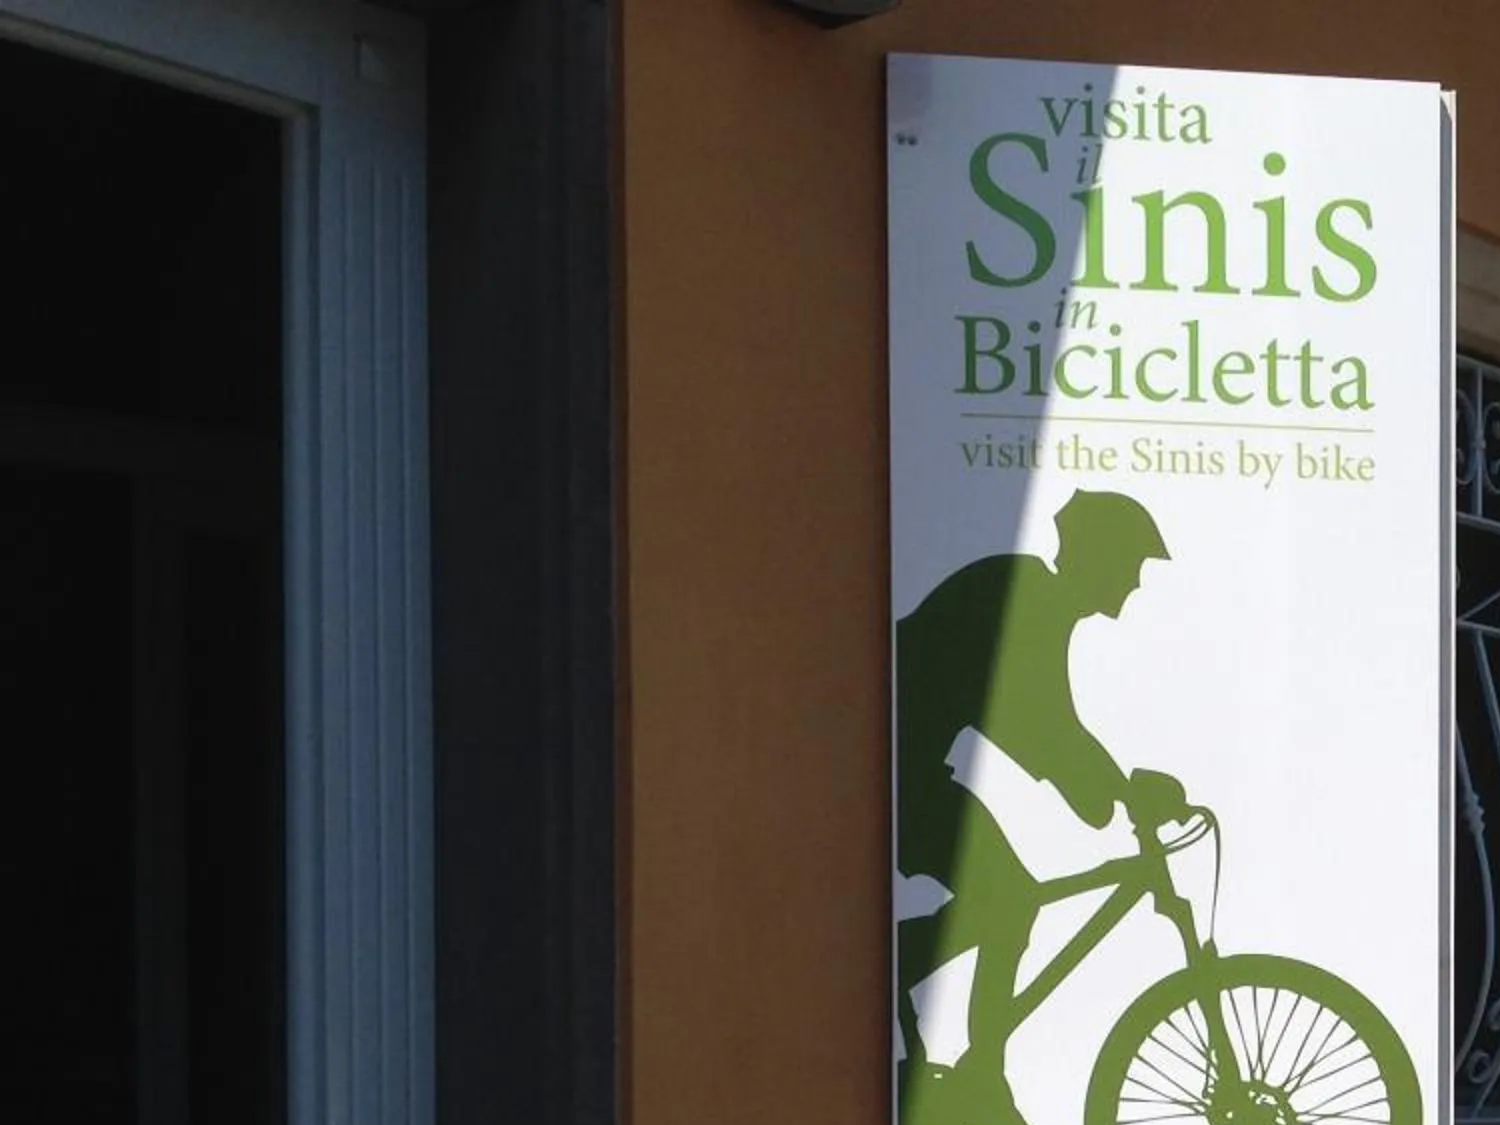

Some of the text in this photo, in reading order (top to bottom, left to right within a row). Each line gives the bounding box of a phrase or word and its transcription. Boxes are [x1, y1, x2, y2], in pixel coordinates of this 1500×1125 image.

[1040, 83, 1212, 144] visita
[1075, 144, 1103, 186] il
[965, 131, 1378, 304] Sinis
[1053, 288, 1098, 330] in
[953, 314, 1375, 413] Bicicletta
[960, 434, 1376, 491] visit the Sinis by bike
